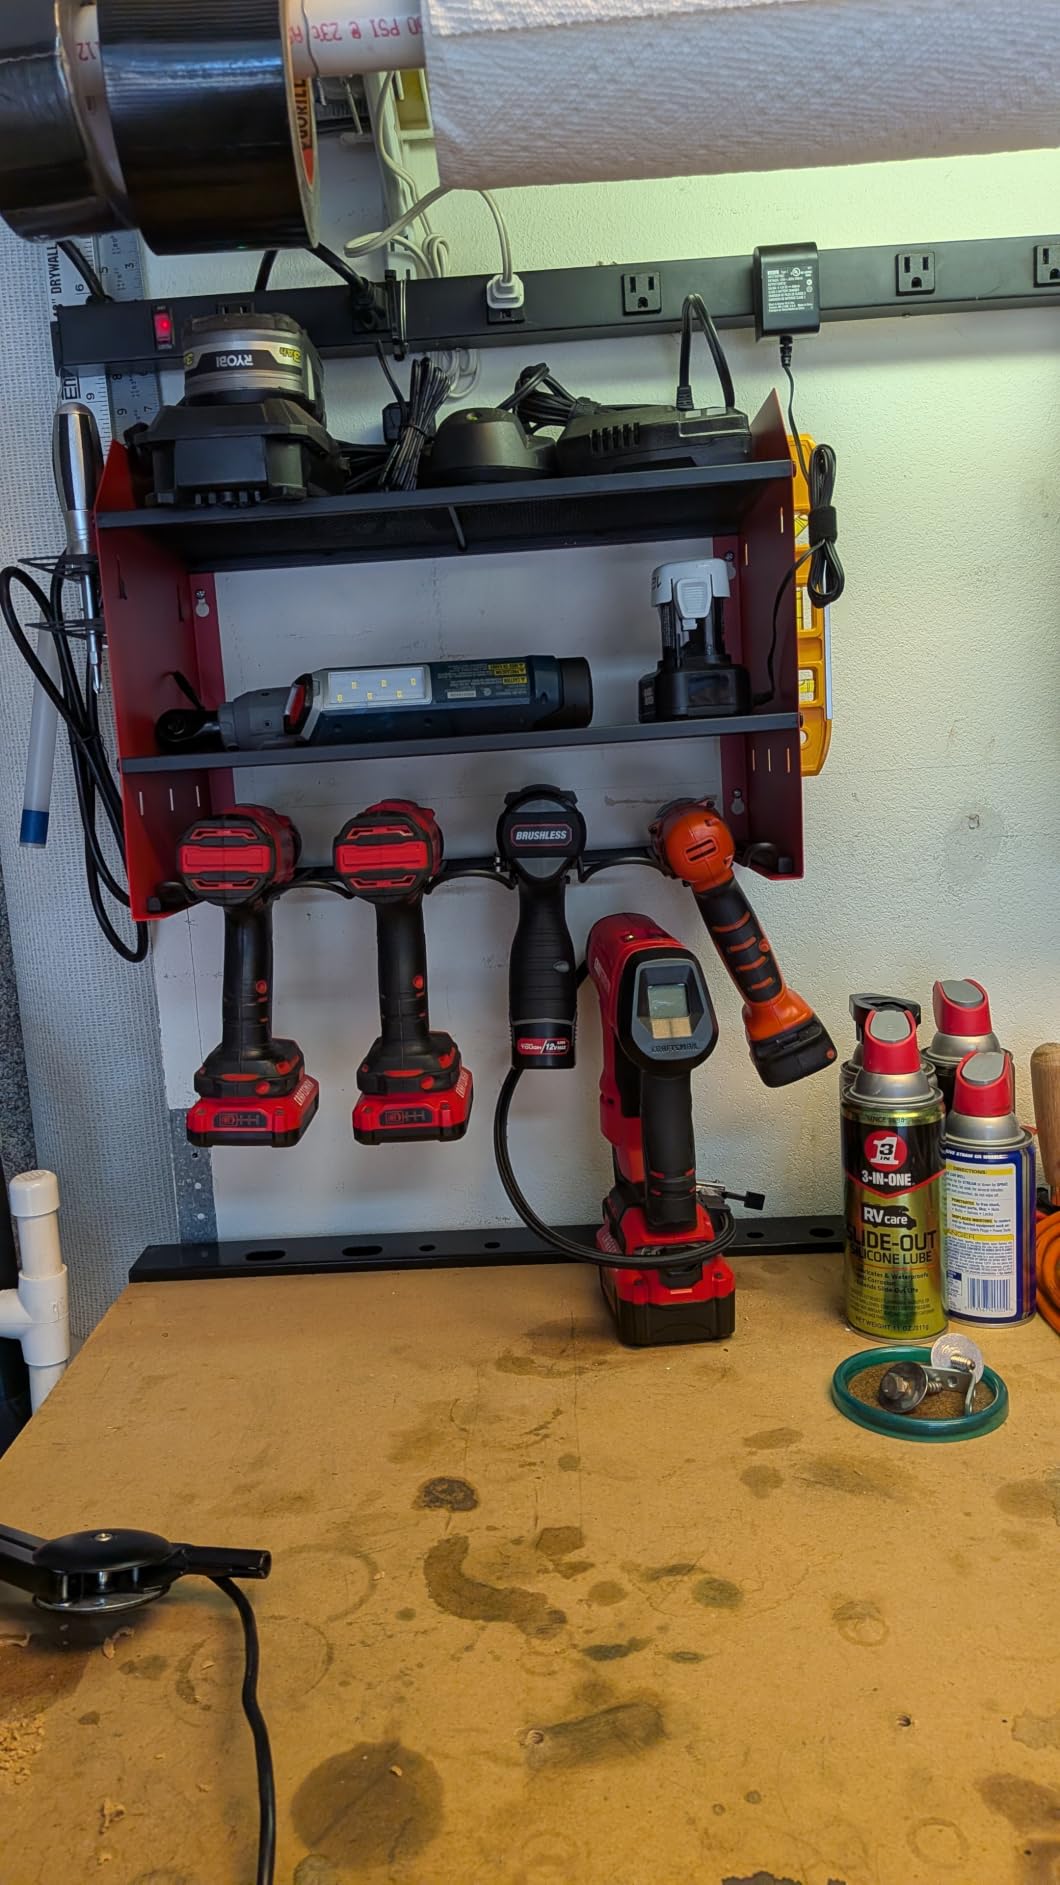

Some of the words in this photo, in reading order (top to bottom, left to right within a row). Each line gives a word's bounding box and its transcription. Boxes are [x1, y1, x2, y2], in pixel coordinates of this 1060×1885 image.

[370, 18, 400, 38] PSI
[47, 245, 62, 294] DRYWALL
[125, 262, 134, 270] 3
[75, 283, 84, 292] 6
[216, 354, 254, 369] RYOBI
[86, 392, 95, 400] 9
[117, 408, 127, 416] 9
[516, 831, 567, 840] BRUSHLESS
[861, 1170, 912, 1187] 3-IN-ONE
[864, 1206, 884, 1223] RV
[884, 1215, 908, 1225] care
[903, 1250, 932, 1265] LUBE
